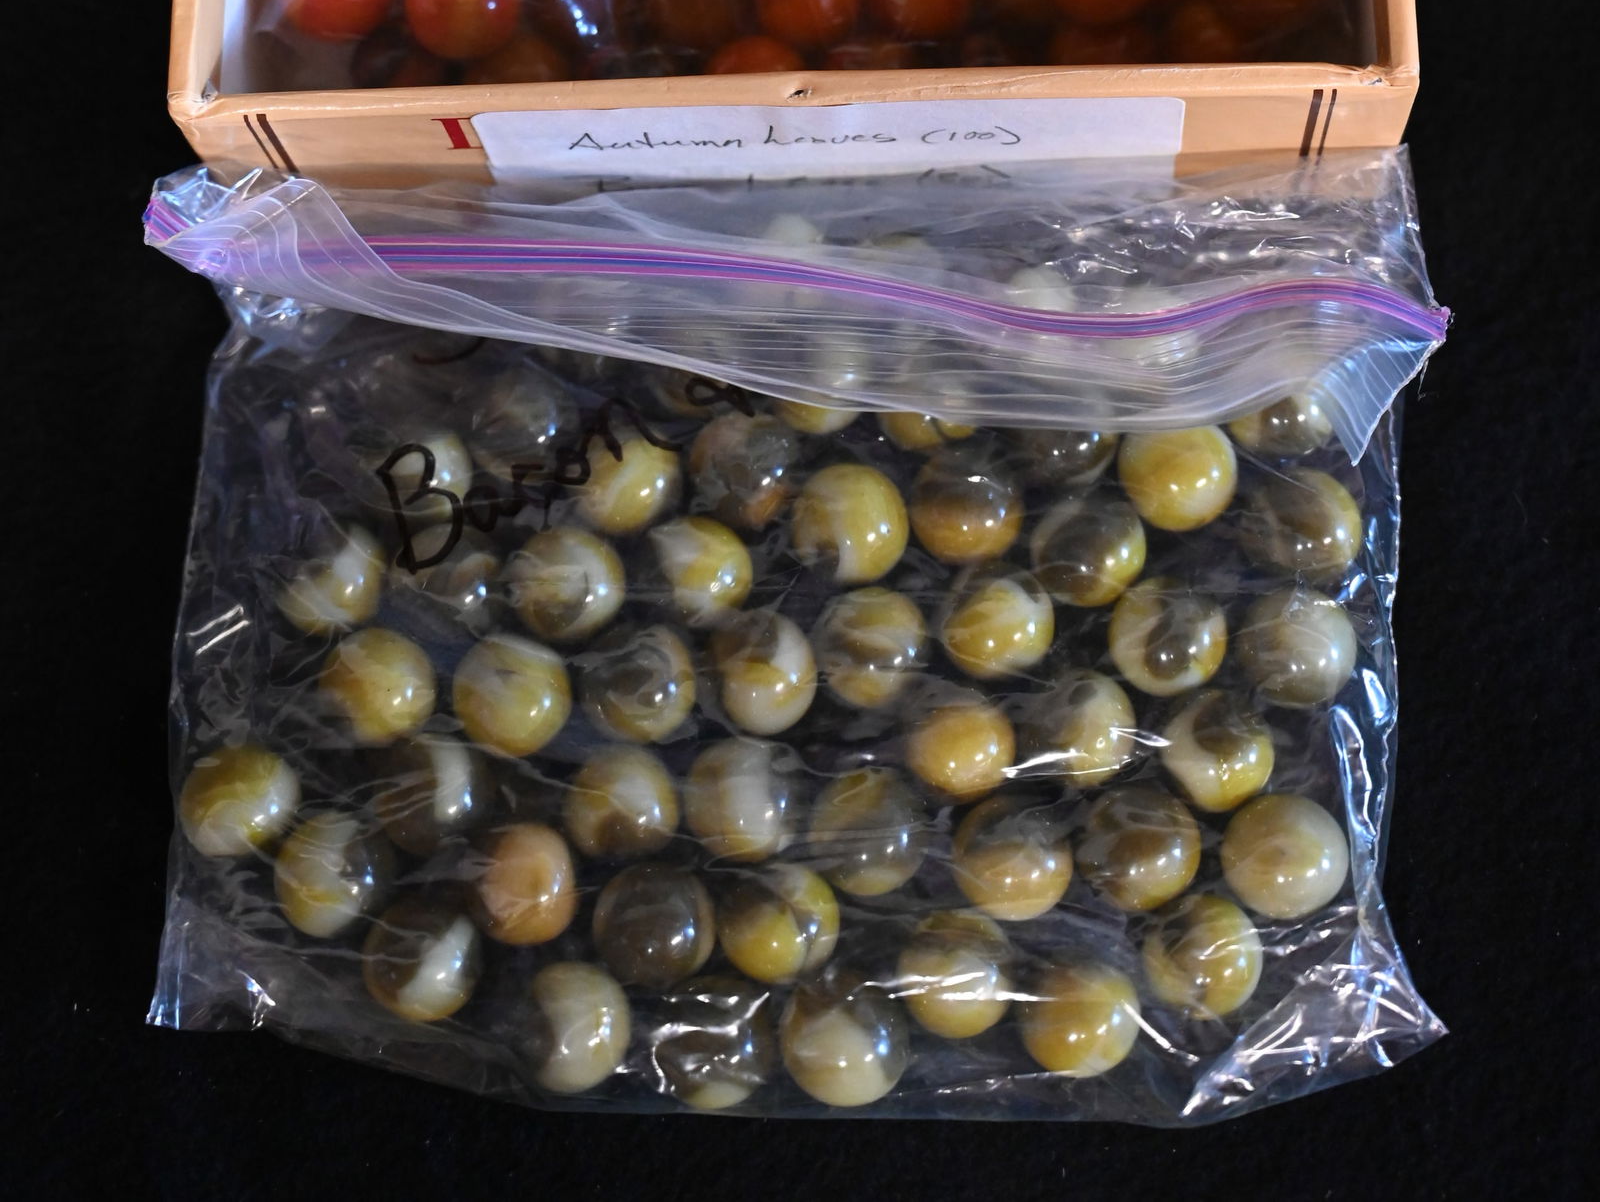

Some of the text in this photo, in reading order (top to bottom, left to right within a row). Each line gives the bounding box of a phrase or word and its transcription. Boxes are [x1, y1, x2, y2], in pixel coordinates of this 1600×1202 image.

[569, 125, 1022, 151] Autumn Leaves (100)
